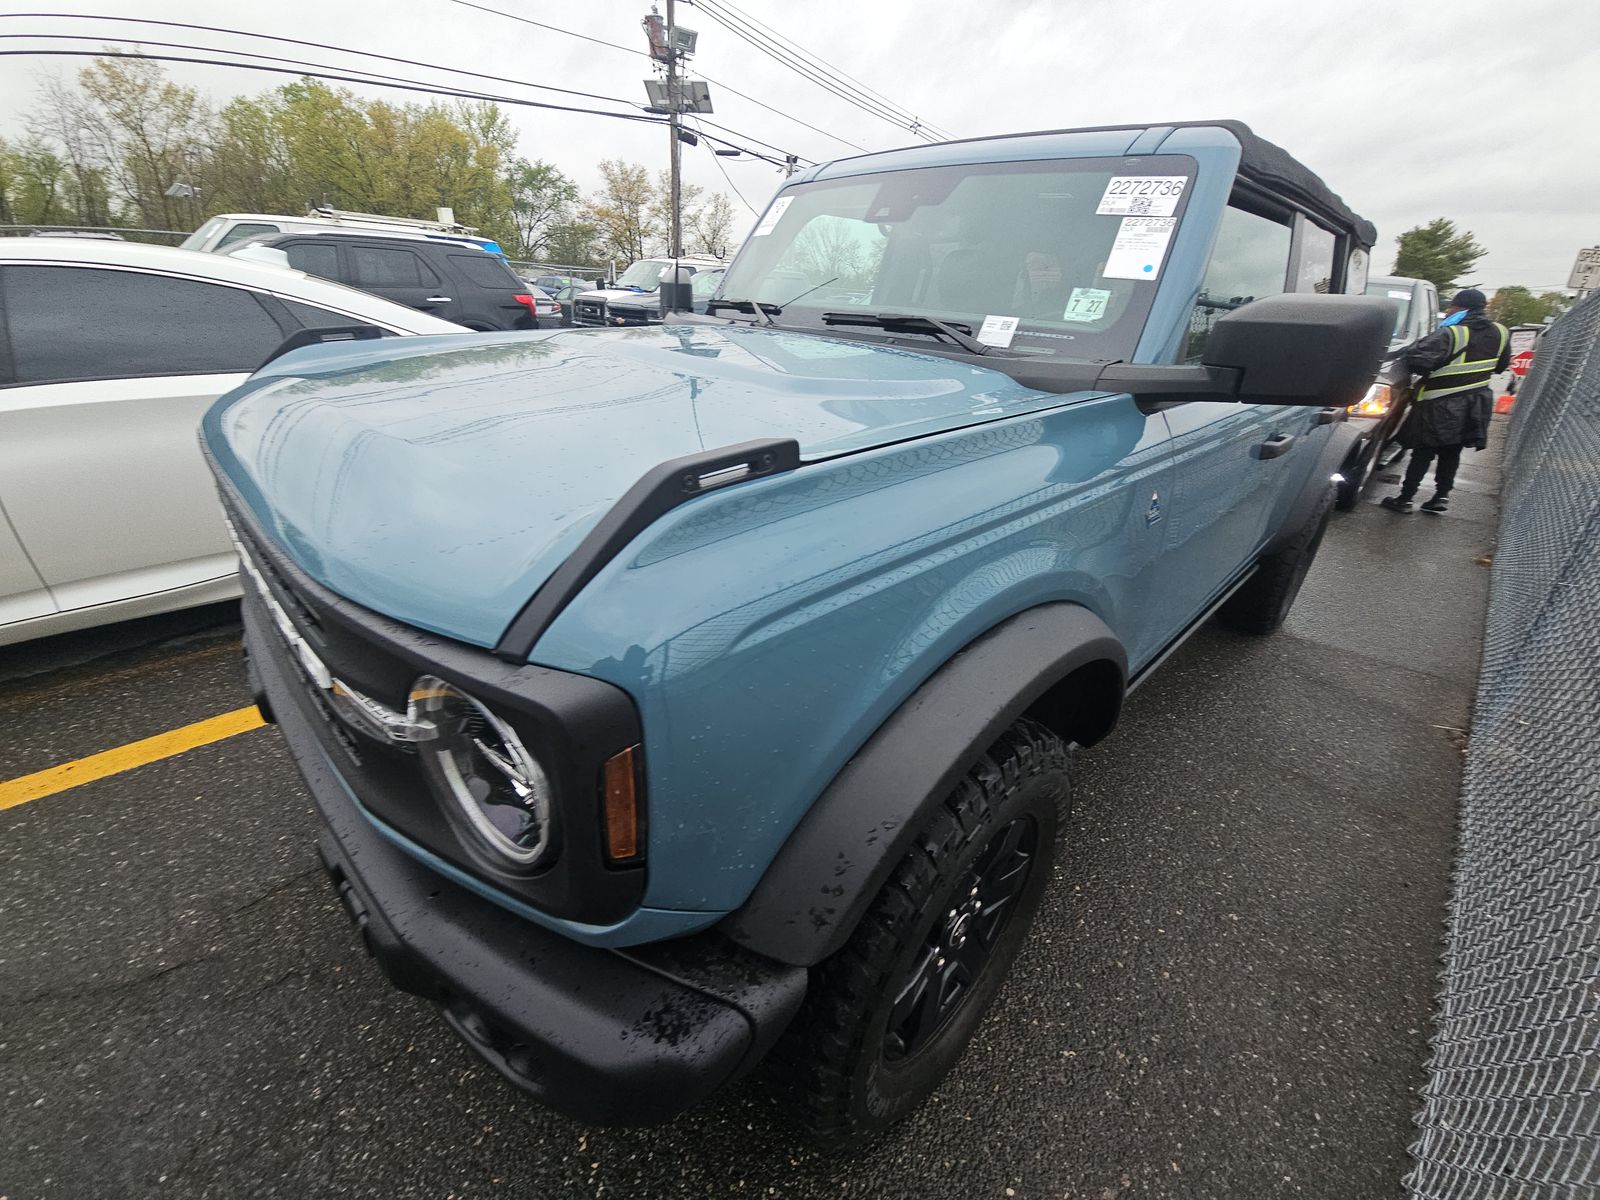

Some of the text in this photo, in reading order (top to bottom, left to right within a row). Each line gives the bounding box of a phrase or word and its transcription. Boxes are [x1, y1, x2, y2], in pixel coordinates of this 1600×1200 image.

[1109, 180, 1184, 196] 2272736
[1125, 218, 1176, 227] 2272736
[1578, 252, 1600, 263] SPEE
[1072, 299, 1103, 313] 7 27
[1510, 359, 1533, 369] STO
